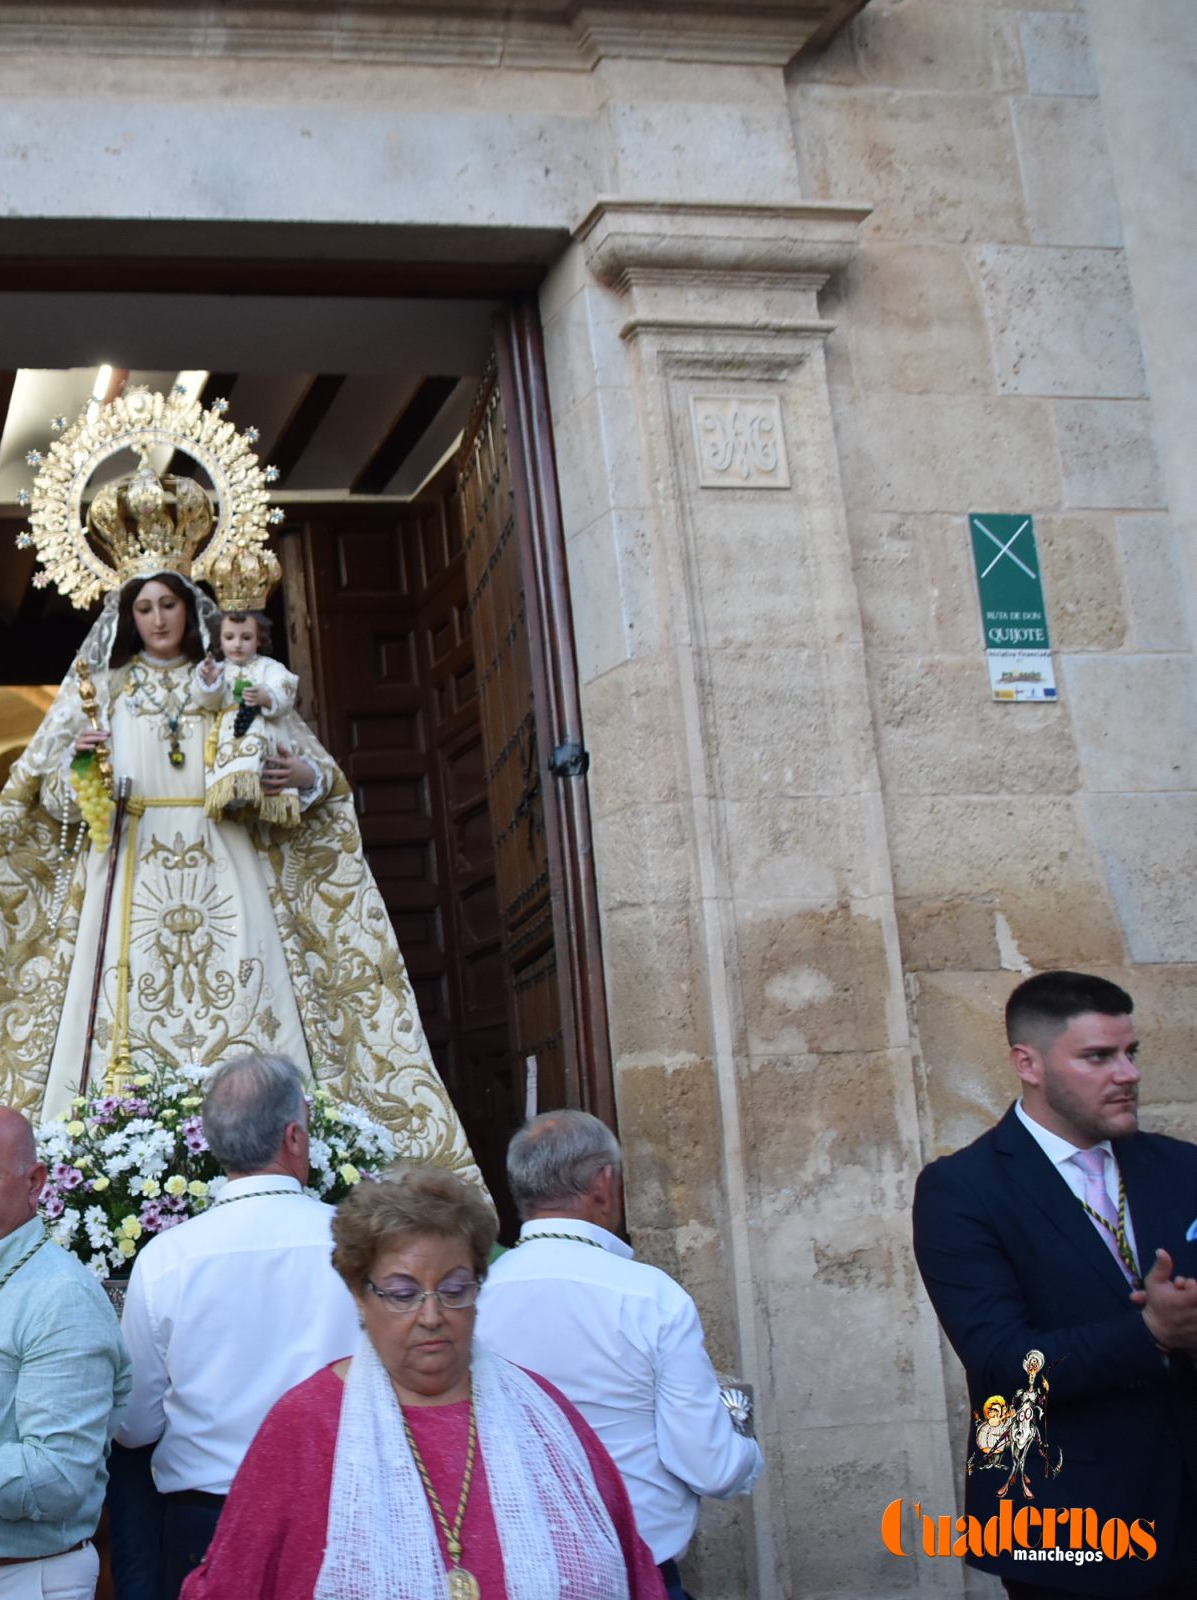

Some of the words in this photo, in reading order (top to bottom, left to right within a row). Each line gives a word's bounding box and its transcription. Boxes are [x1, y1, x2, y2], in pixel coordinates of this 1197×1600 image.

[987, 611, 1008, 620] RUTA
[1010, 611, 1021, 620] DE
[1022, 611, 1041, 620] DON
[988, 628, 1045, 643] QUIJOTE
